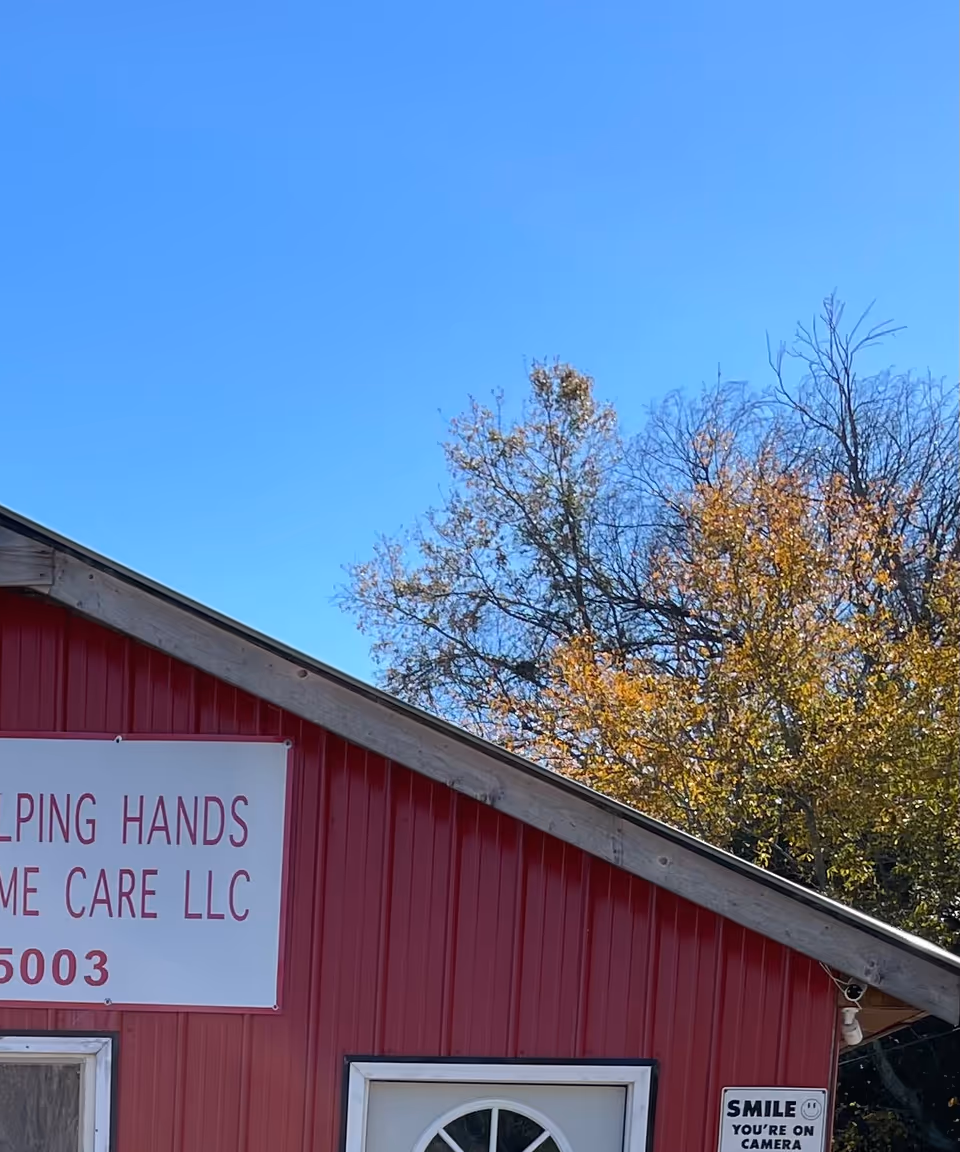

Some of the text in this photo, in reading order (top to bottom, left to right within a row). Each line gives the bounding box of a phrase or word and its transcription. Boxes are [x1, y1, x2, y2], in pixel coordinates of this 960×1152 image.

[121, 795, 249, 848] HANDS
[65, 866, 159, 919] CARE
[184, 869, 251, 921] LLC
[727, 1099, 797, 1118] SMILE
[732, 1124, 814, 1136] YOU'RE ON
[741, 1138, 802, 1150] CAMERA
